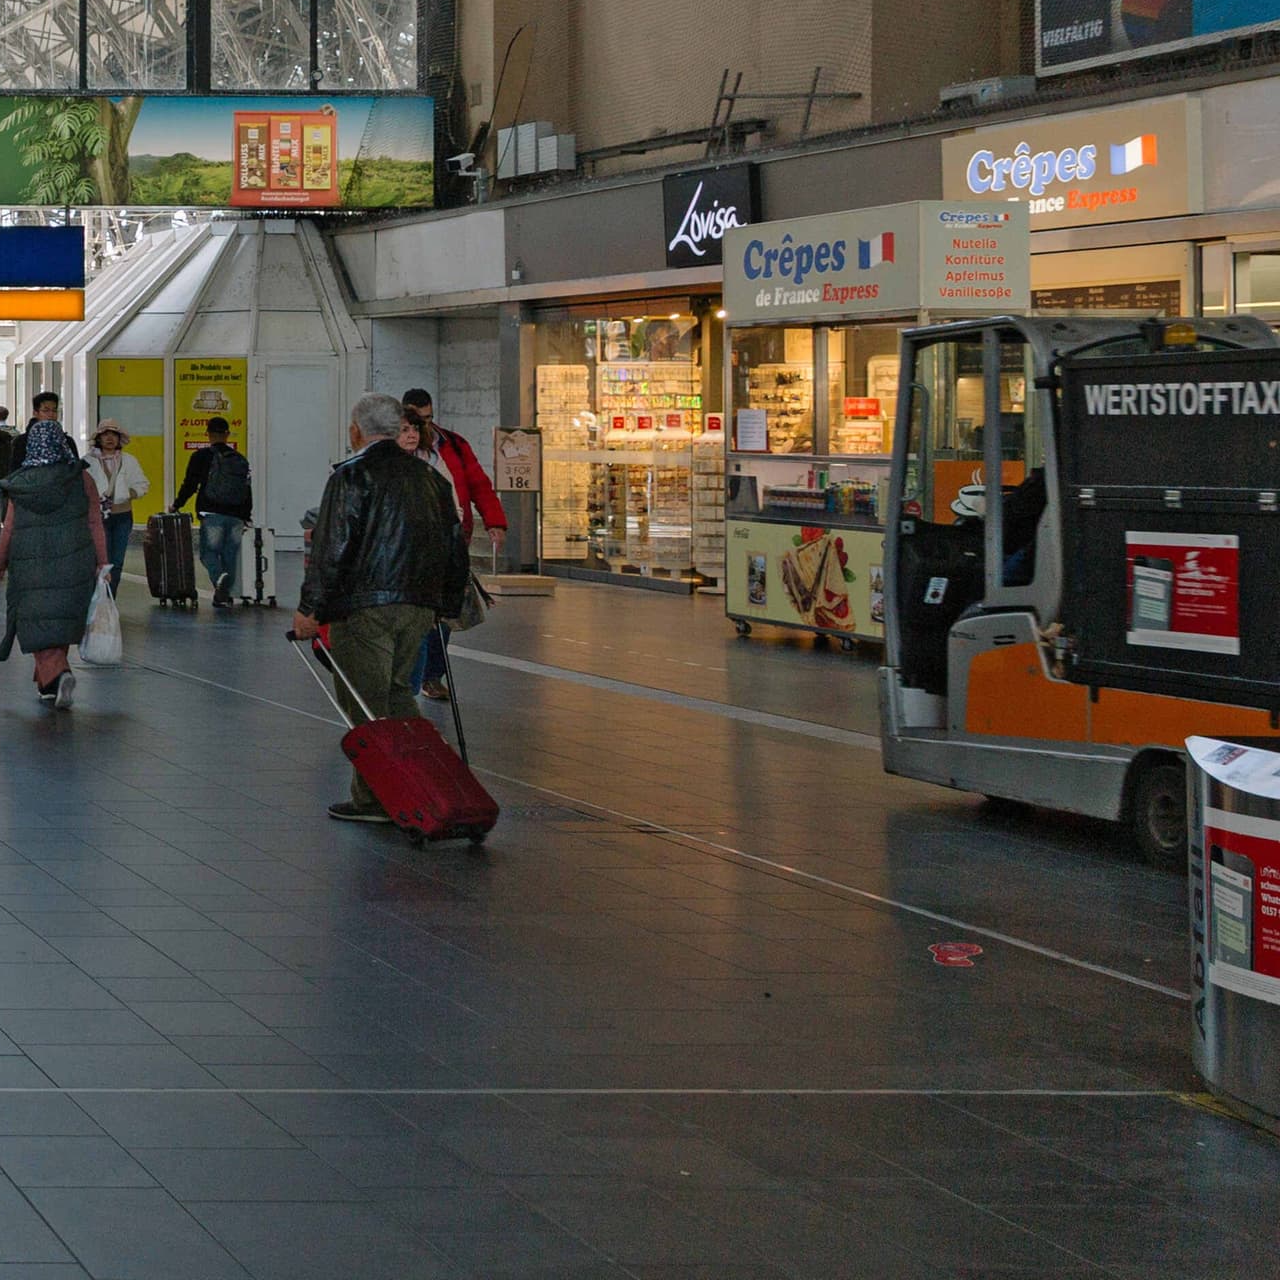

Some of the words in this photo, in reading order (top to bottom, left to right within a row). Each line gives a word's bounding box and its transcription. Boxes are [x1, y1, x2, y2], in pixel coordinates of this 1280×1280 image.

[1042, 19, 1105, 48] VIELFÄLTIG
[966, 141, 1097, 195] Crêpes
[1067, 187, 1137, 211] Express
[668, 180, 749, 257] Lovisa
[939, 211, 990, 223] Crêpes
[952, 239, 998, 249] Nutella
[743, 233, 847, 285] Crêpes
[945, 253, 1005, 265] Konfitüre
[945, 271, 1005, 282] Apfelmus
[756, 288, 771, 307] de
[773, 286, 820, 306] France
[822, 282, 879, 304] Express
[939, 287, 1012, 298] Vanillesoße
[180, 374, 195, 382] LOTTO
[508, 476, 530, 489] 18€
